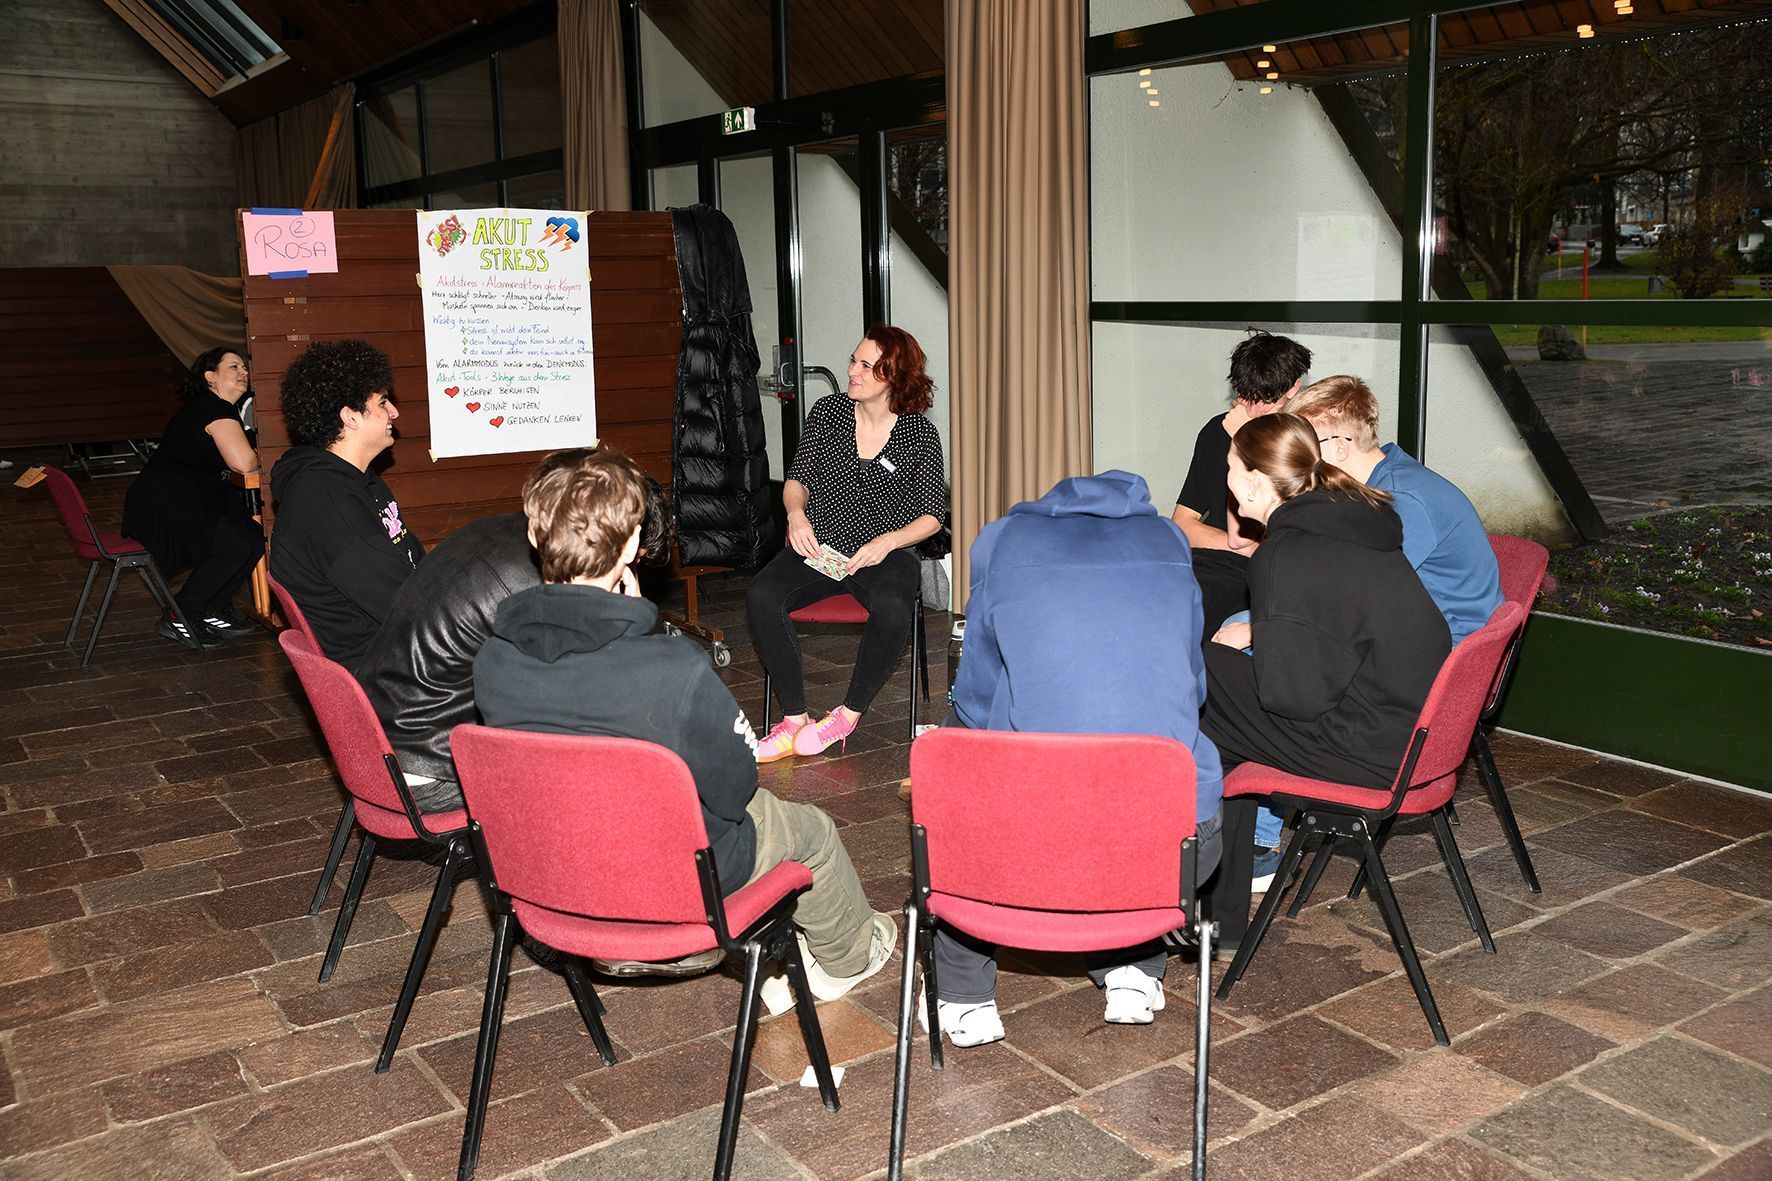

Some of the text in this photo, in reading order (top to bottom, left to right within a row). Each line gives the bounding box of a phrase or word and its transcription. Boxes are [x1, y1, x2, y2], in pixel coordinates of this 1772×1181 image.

[293, 220, 306, 234] 2
[472, 217, 533, 246] AKUT
[480, 248, 550, 272] STRESS
[544, 278, 557, 291] des
[463, 385, 540, 397] KÖRPER BERUHIGEN
[483, 401, 541, 412] SINNE NUTZEN
[506, 413, 582, 426] GEDANKEN LENKEN
